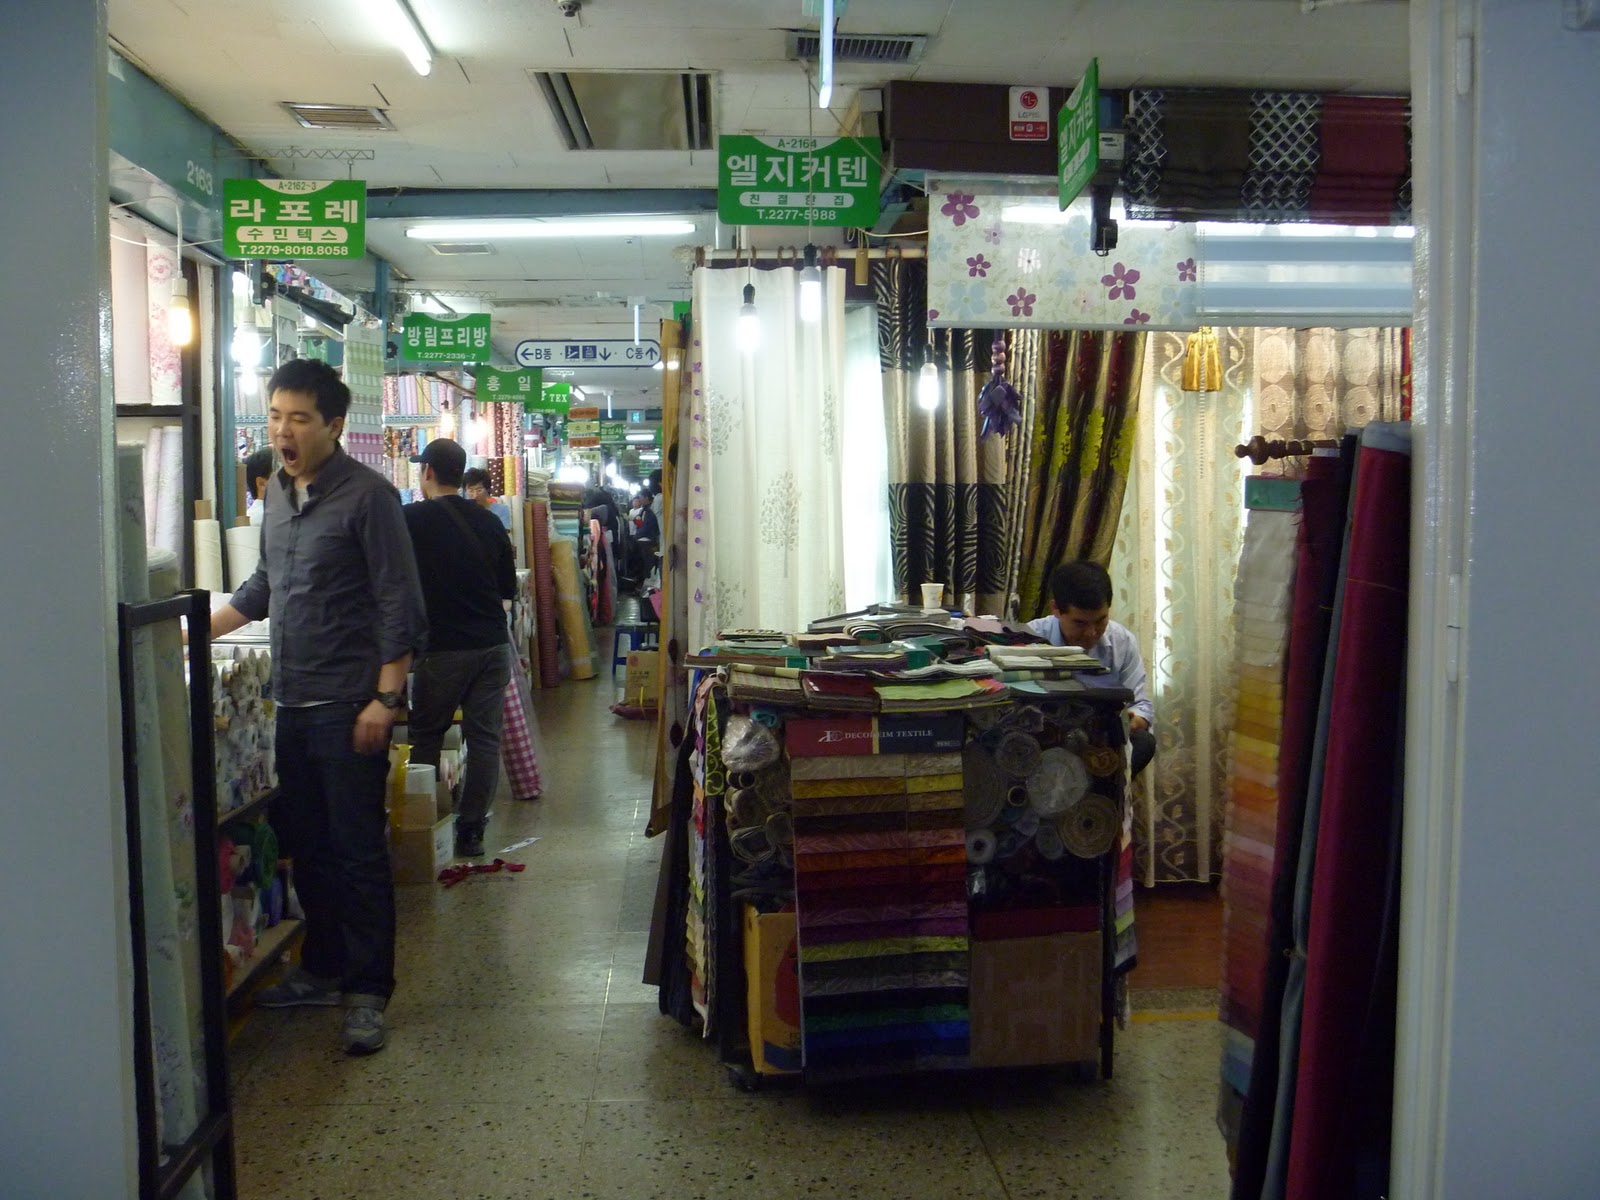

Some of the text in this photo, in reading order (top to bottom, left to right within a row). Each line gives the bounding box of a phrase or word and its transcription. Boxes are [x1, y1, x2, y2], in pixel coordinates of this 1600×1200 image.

[778, 138, 817, 148] A-2164
[726, 154, 867, 187] 엘지커텐
[187, 160, 212, 195] 2163
[757, 208, 836, 220] T.2277-5988
[247, 227, 337, 241] 수민텍스
[239, 245, 348, 256] T.2279-8018.8058
[535, 348, 552, 360] B동
[625, 347, 644, 360] C동
[549, 393, 567, 403] TEX
[896, 729, 933, 738] TEXTILE
